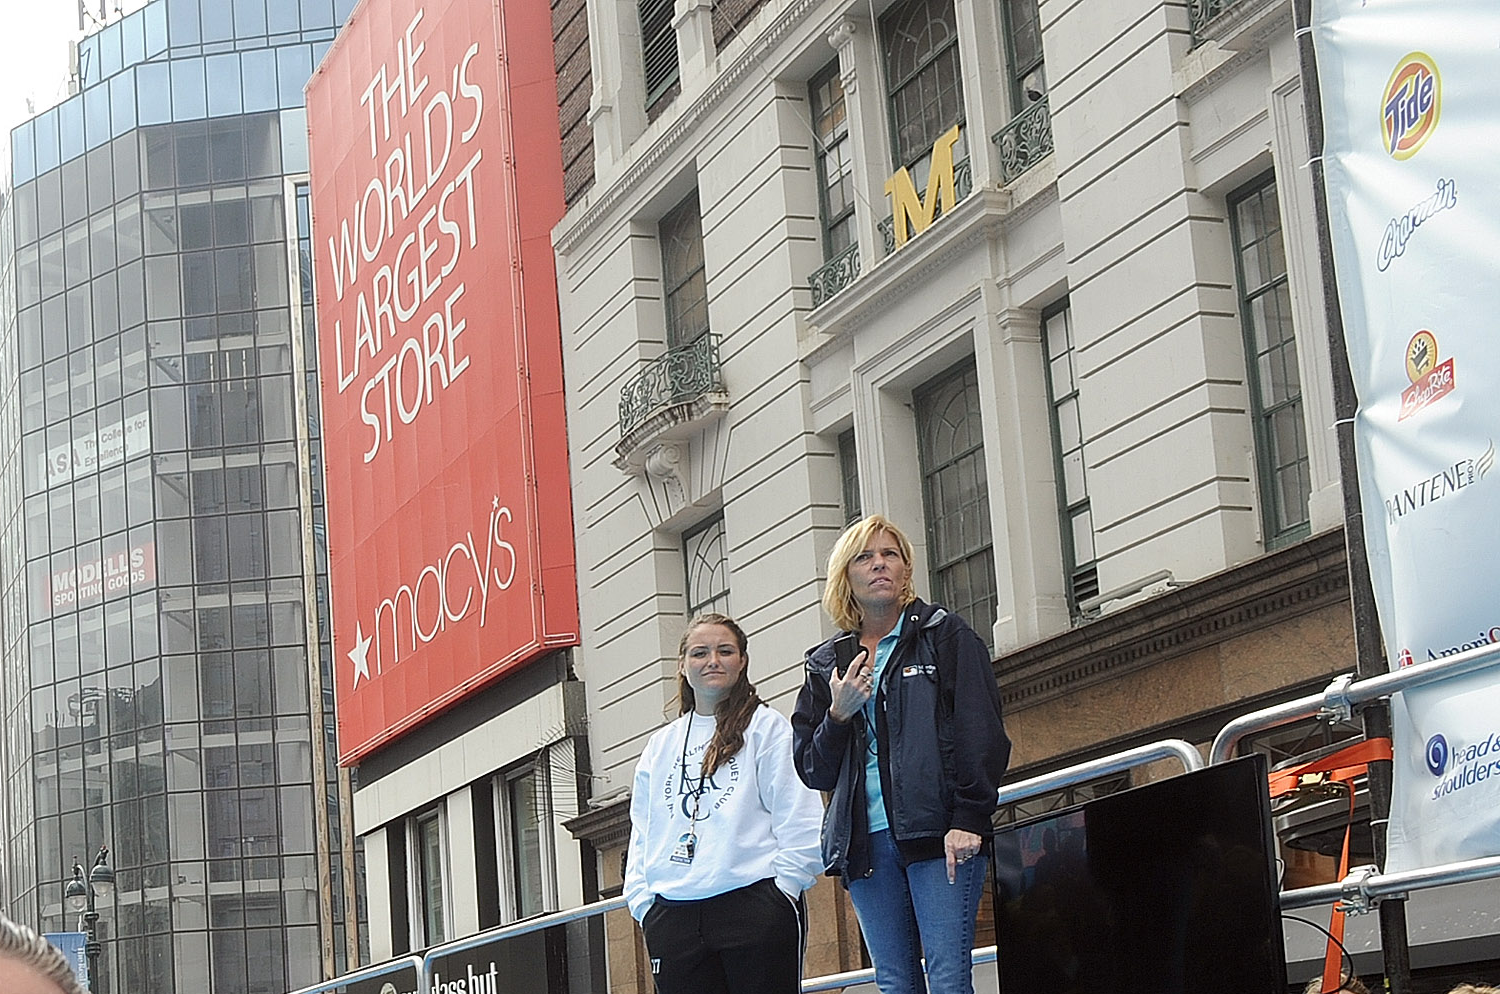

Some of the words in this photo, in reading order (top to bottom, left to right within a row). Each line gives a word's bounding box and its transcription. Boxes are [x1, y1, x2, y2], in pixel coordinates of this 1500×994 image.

[360, 8, 429, 159] THE
[1385, 69, 1434, 155] Tide
[328, 42, 484, 301] WORLD'S
[1377, 178, 1457, 272] Charmin
[335, 149, 483, 394] LARGEST
[360, 282, 472, 463] STORE
[1403, 365, 1453, 413] ShopRite
[84, 443, 128, 467] Exellenc
[101, 424, 132, 443] Collee
[1386, 460, 1469, 525] PANTENE
[54, 581, 102, 606] SPOTING
[729, 756, 740, 782] QUET
[1452, 733, 1494, 769] head
[664, 774, 675, 801] YORK
[714, 786, 735, 810] CLUB
[1432, 760, 1500, 800] shoulders
